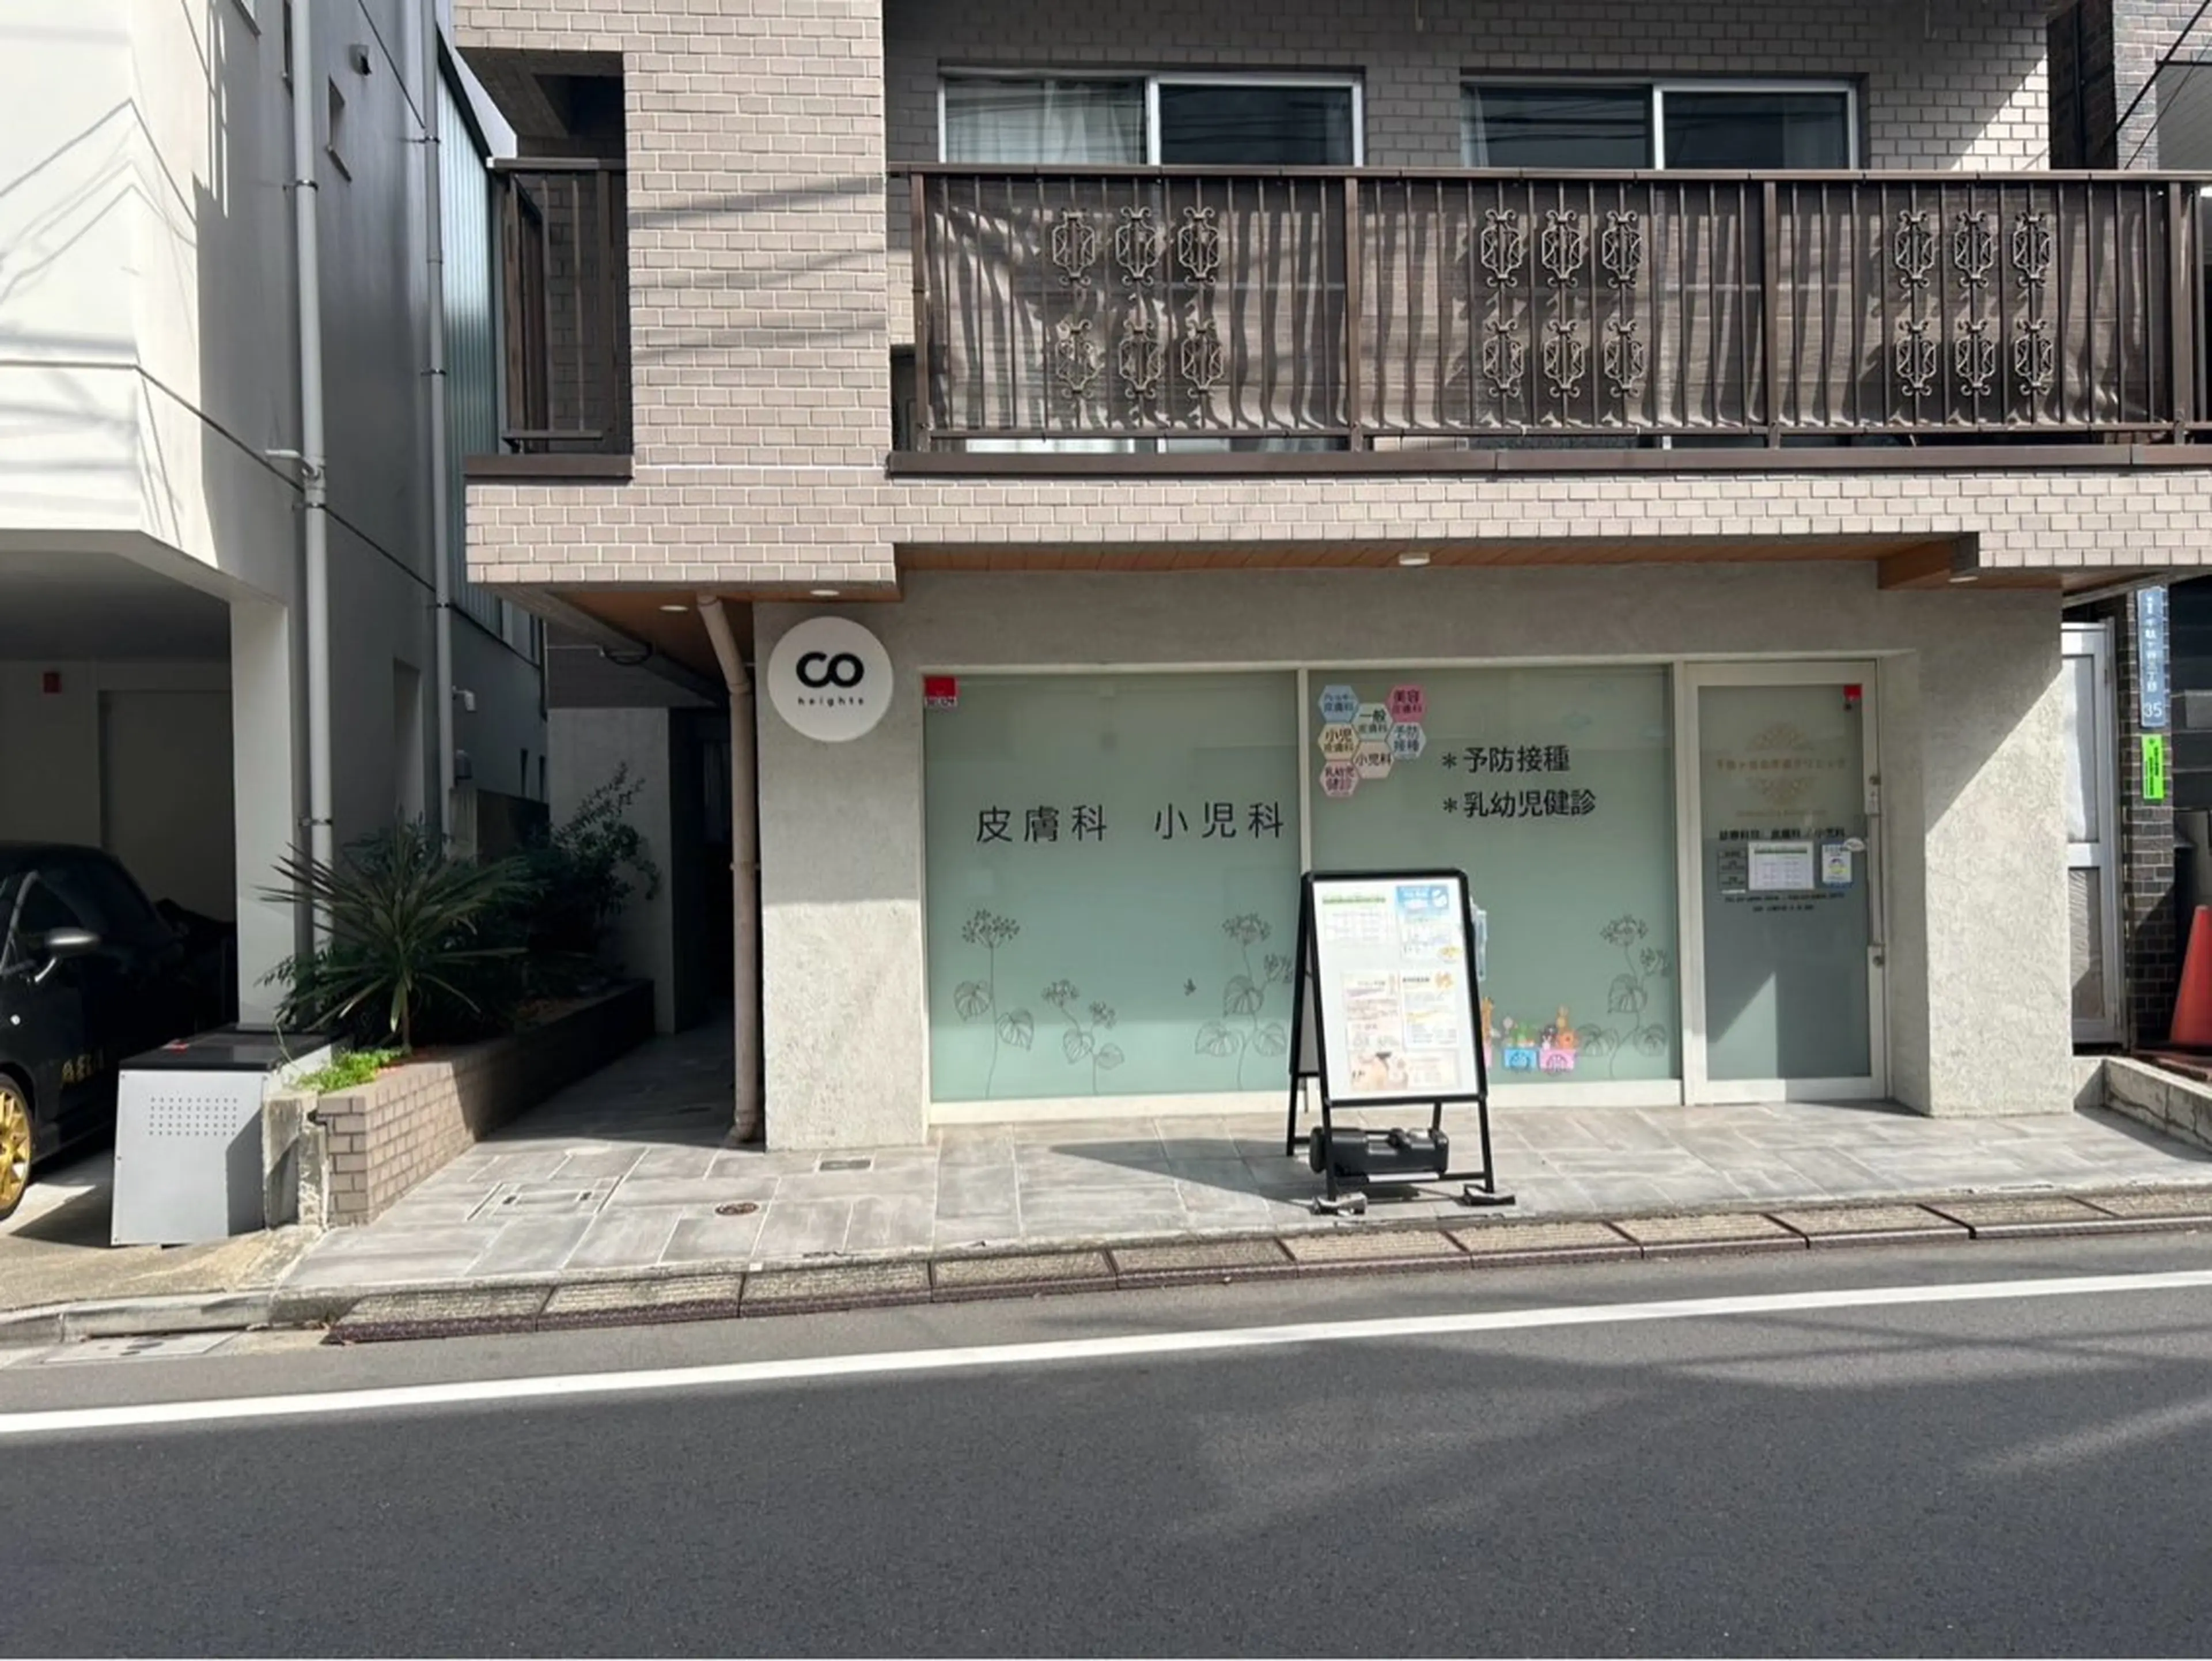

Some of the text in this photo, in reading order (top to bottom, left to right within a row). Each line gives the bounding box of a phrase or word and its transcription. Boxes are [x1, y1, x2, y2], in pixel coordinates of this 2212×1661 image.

[798, 695, 863, 707] heights
[1359, 708, 1387, 722] 一般
[2143, 701, 2162, 717] 35
[1325, 729, 1352, 743] 小児
[1355, 752, 1392, 766] 小児科
[1464, 746, 1570, 773] 予防接種
[1464, 789, 1596, 818] 乳幼児健診
[977, 801, 1283, 843] 皮膚科 小児科
